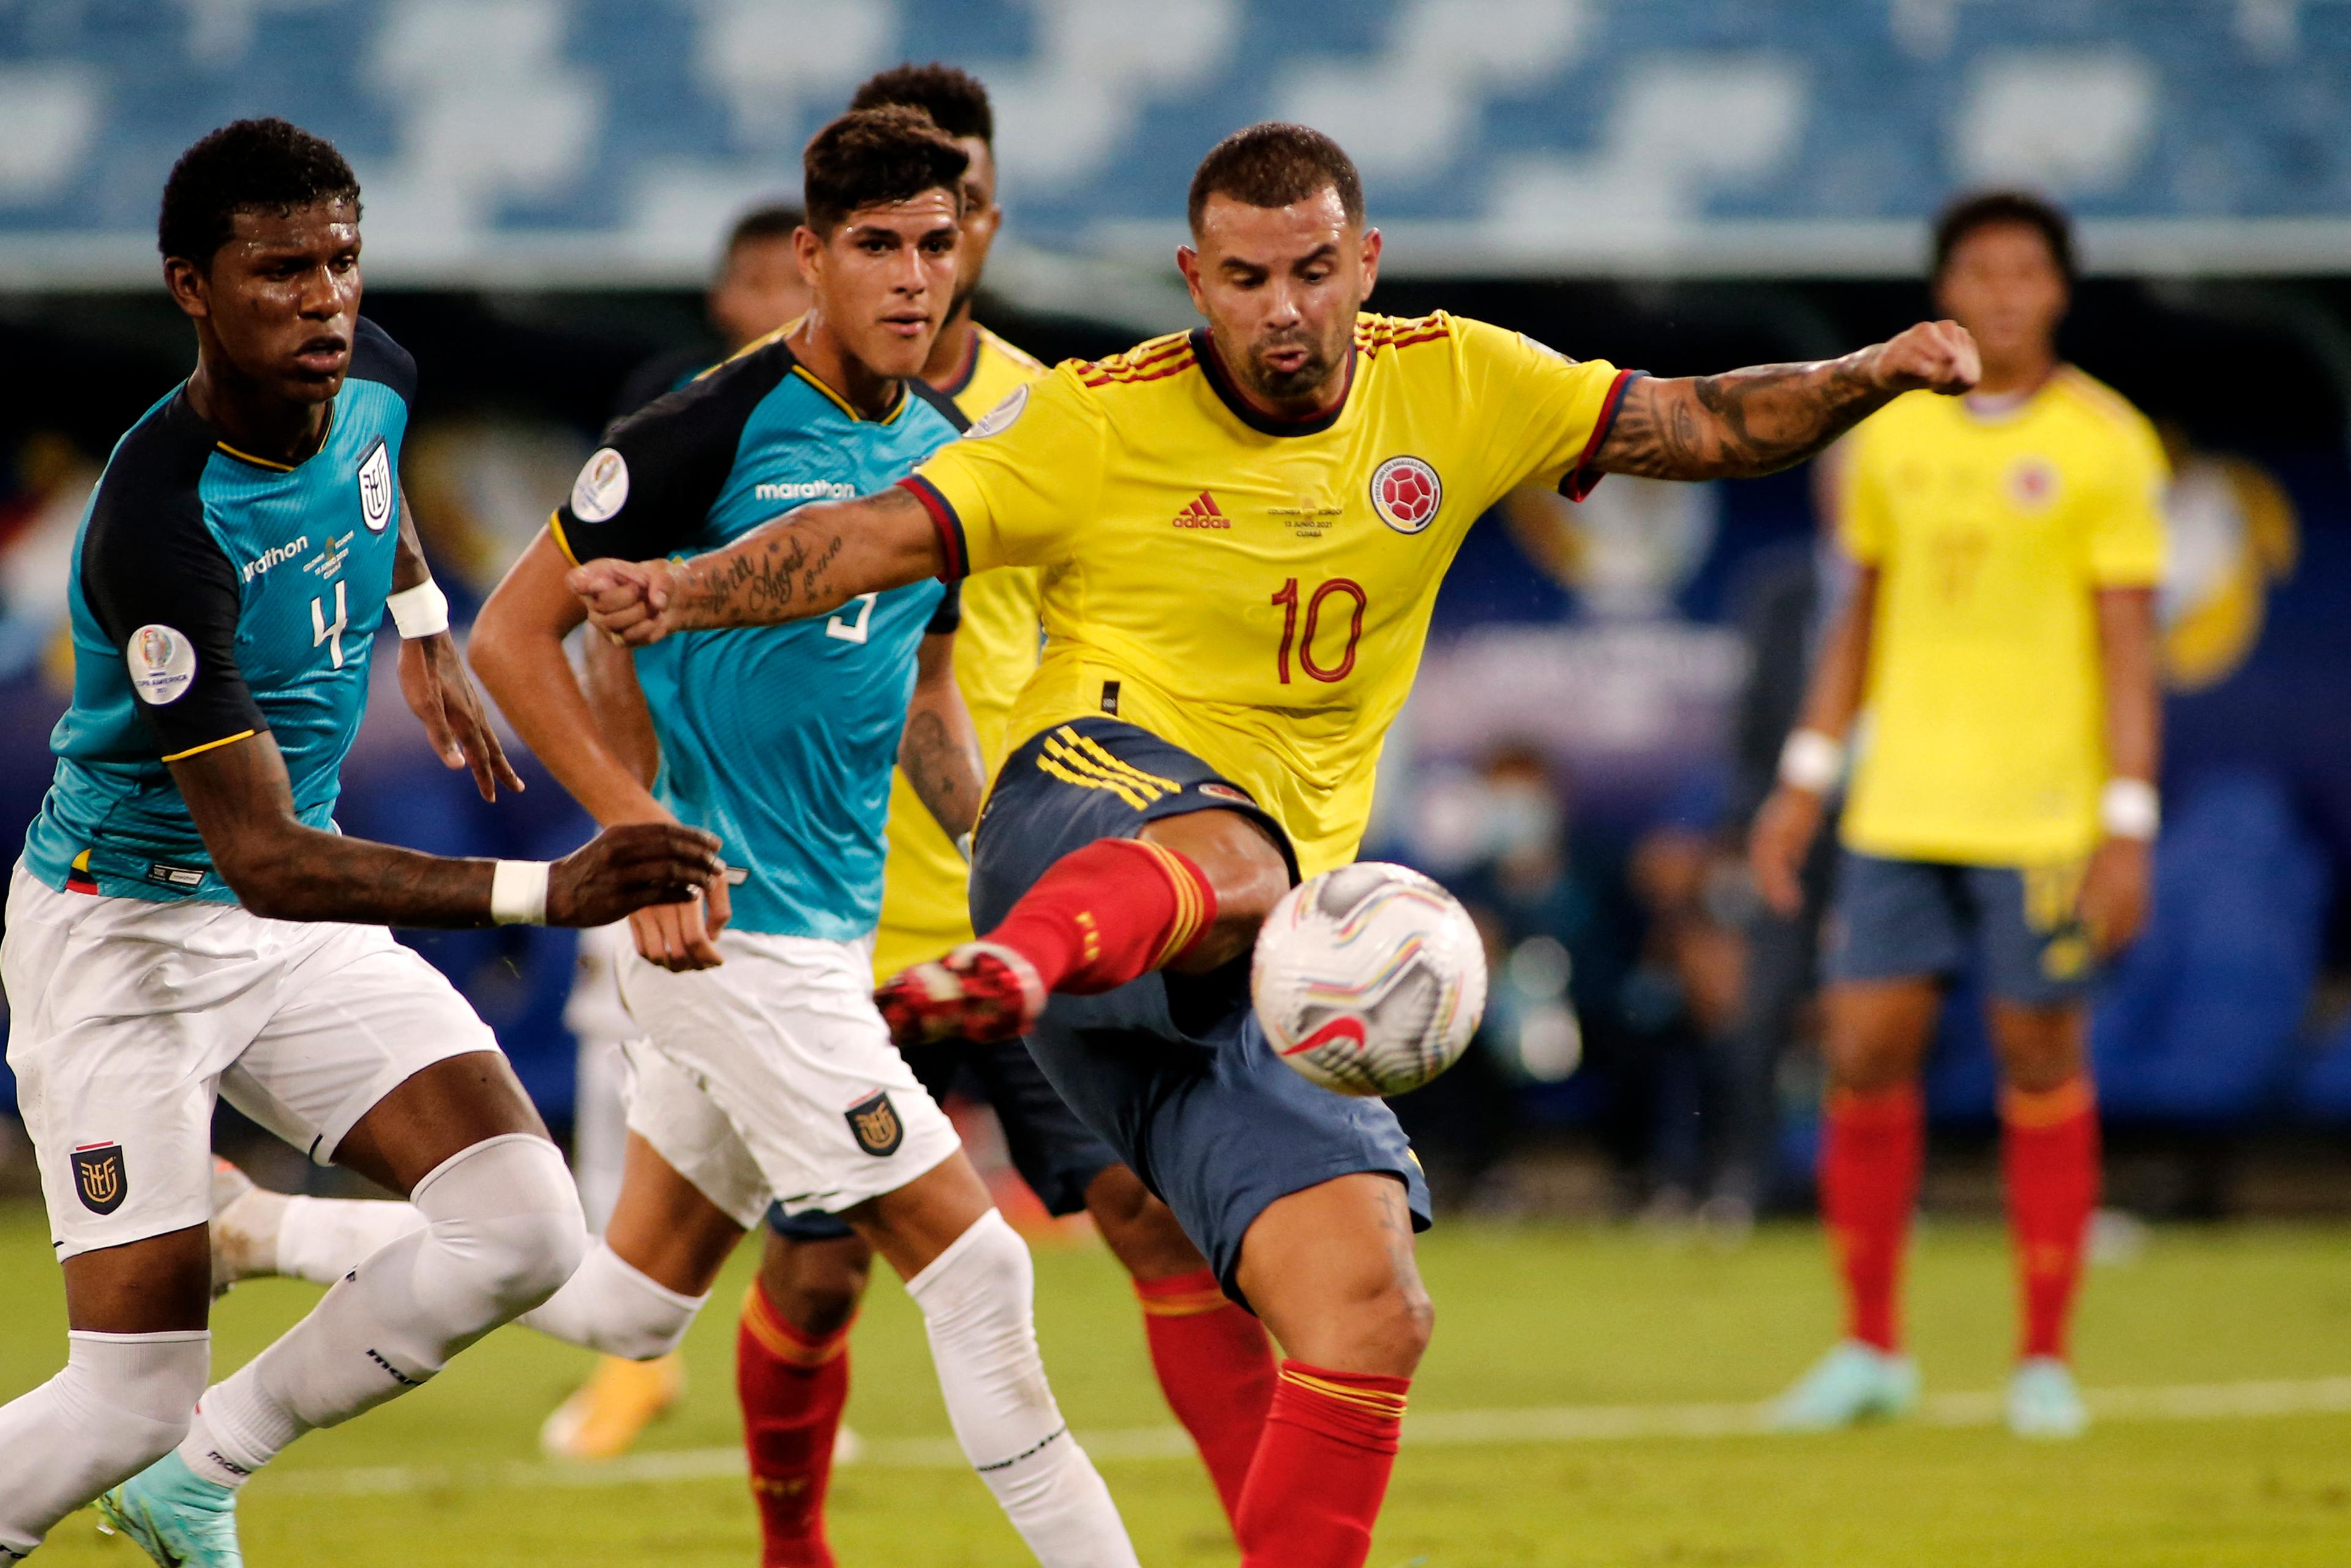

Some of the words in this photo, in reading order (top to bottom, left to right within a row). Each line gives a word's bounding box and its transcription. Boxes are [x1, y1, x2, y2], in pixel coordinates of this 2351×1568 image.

[755, 480, 855, 500] marathon
[1172, 515, 1231, 529] adidas
[242, 535, 309, 583] rathon
[311, 579, 348, 670] 4
[1271, 577, 1367, 684] 10
